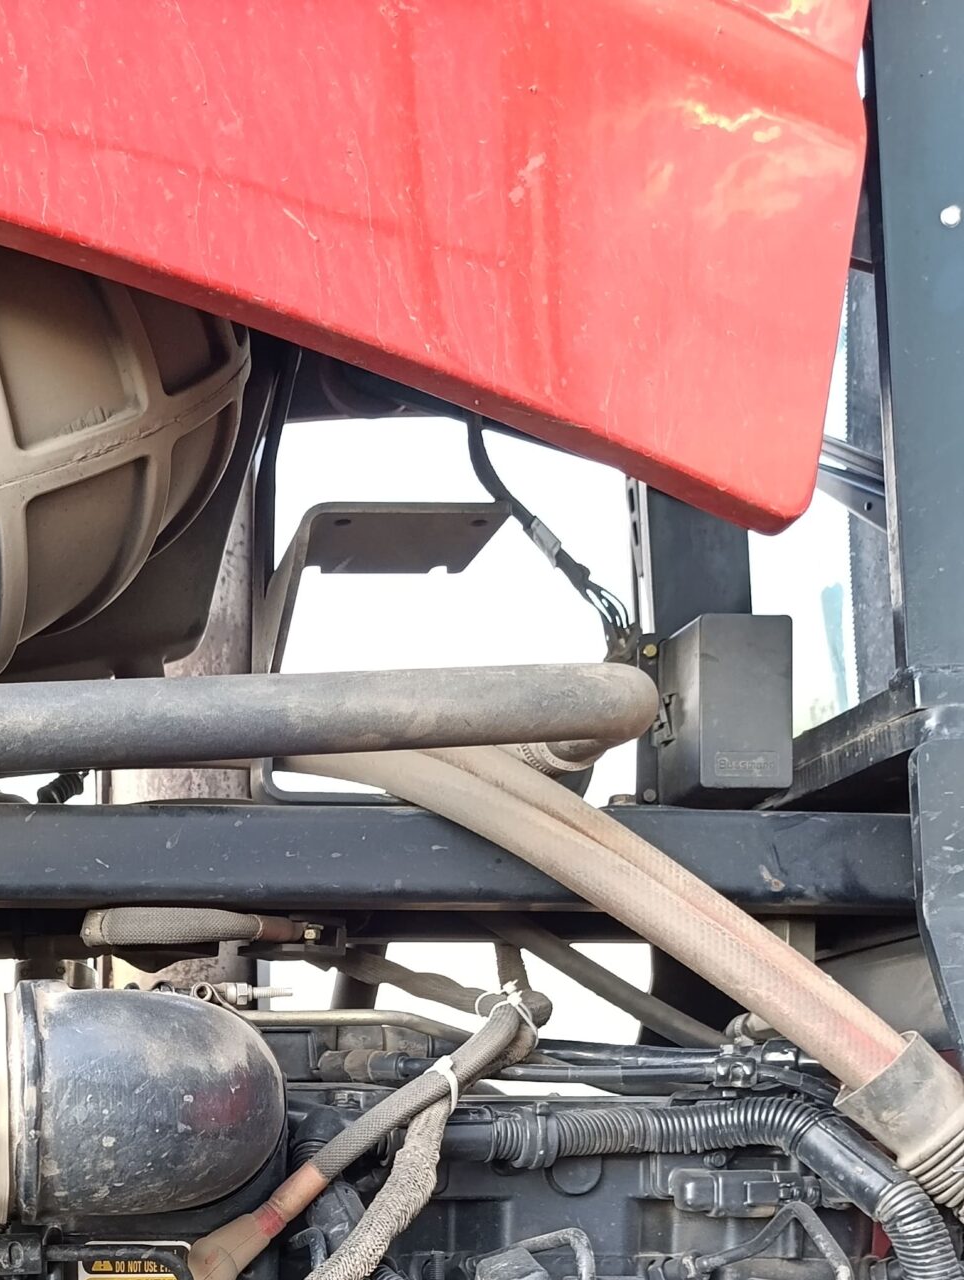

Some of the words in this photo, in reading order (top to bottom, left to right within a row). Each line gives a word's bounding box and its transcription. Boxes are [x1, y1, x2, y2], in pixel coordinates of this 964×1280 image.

[115, 1261, 125, 1272] DO
[128, 1261, 142, 1272] NOT
[144, 1261, 158, 1272] USE
